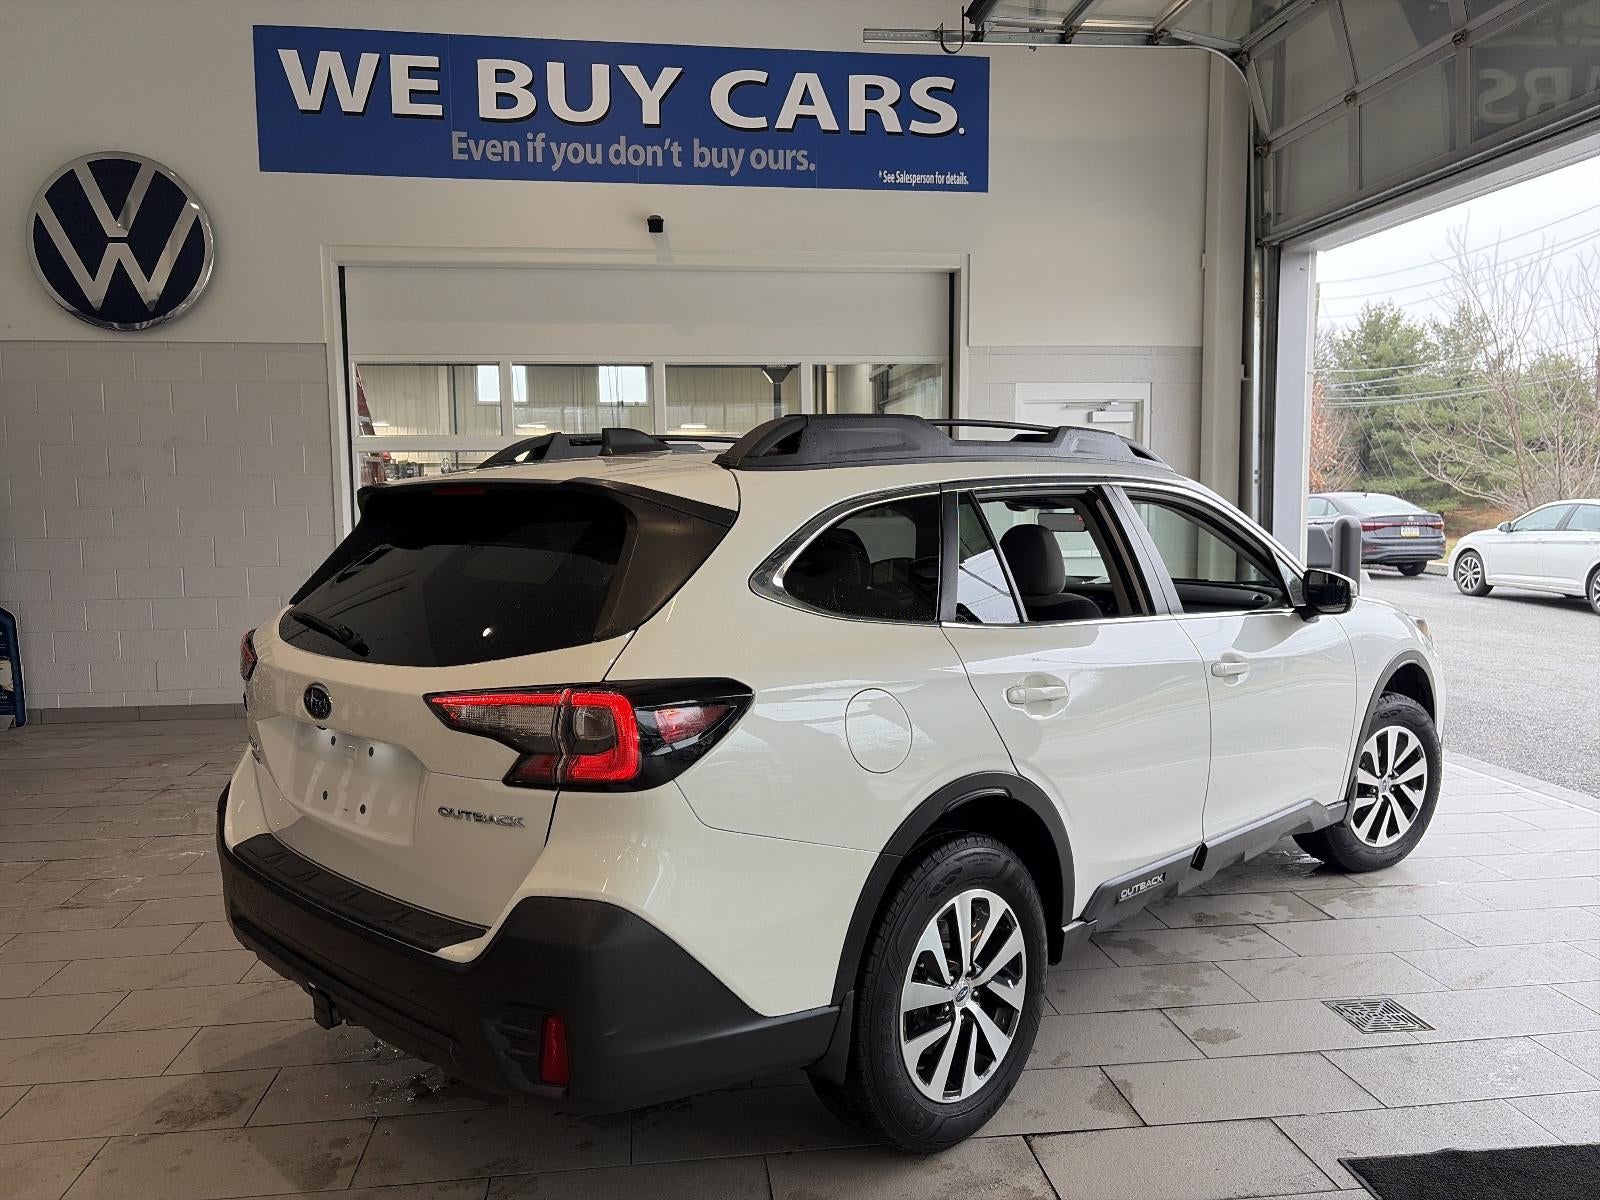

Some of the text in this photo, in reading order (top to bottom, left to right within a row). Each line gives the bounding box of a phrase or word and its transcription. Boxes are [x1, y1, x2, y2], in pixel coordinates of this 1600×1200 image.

[277, 49, 965, 135] WE BUY CARS.
[452, 131, 816, 177] Even if you don't buy ours.
[883, 170, 969, 187] See Salesperson for details.
[438, 806, 526, 828] OUTBACK
[1120, 873, 1165, 900] OUTBACK
